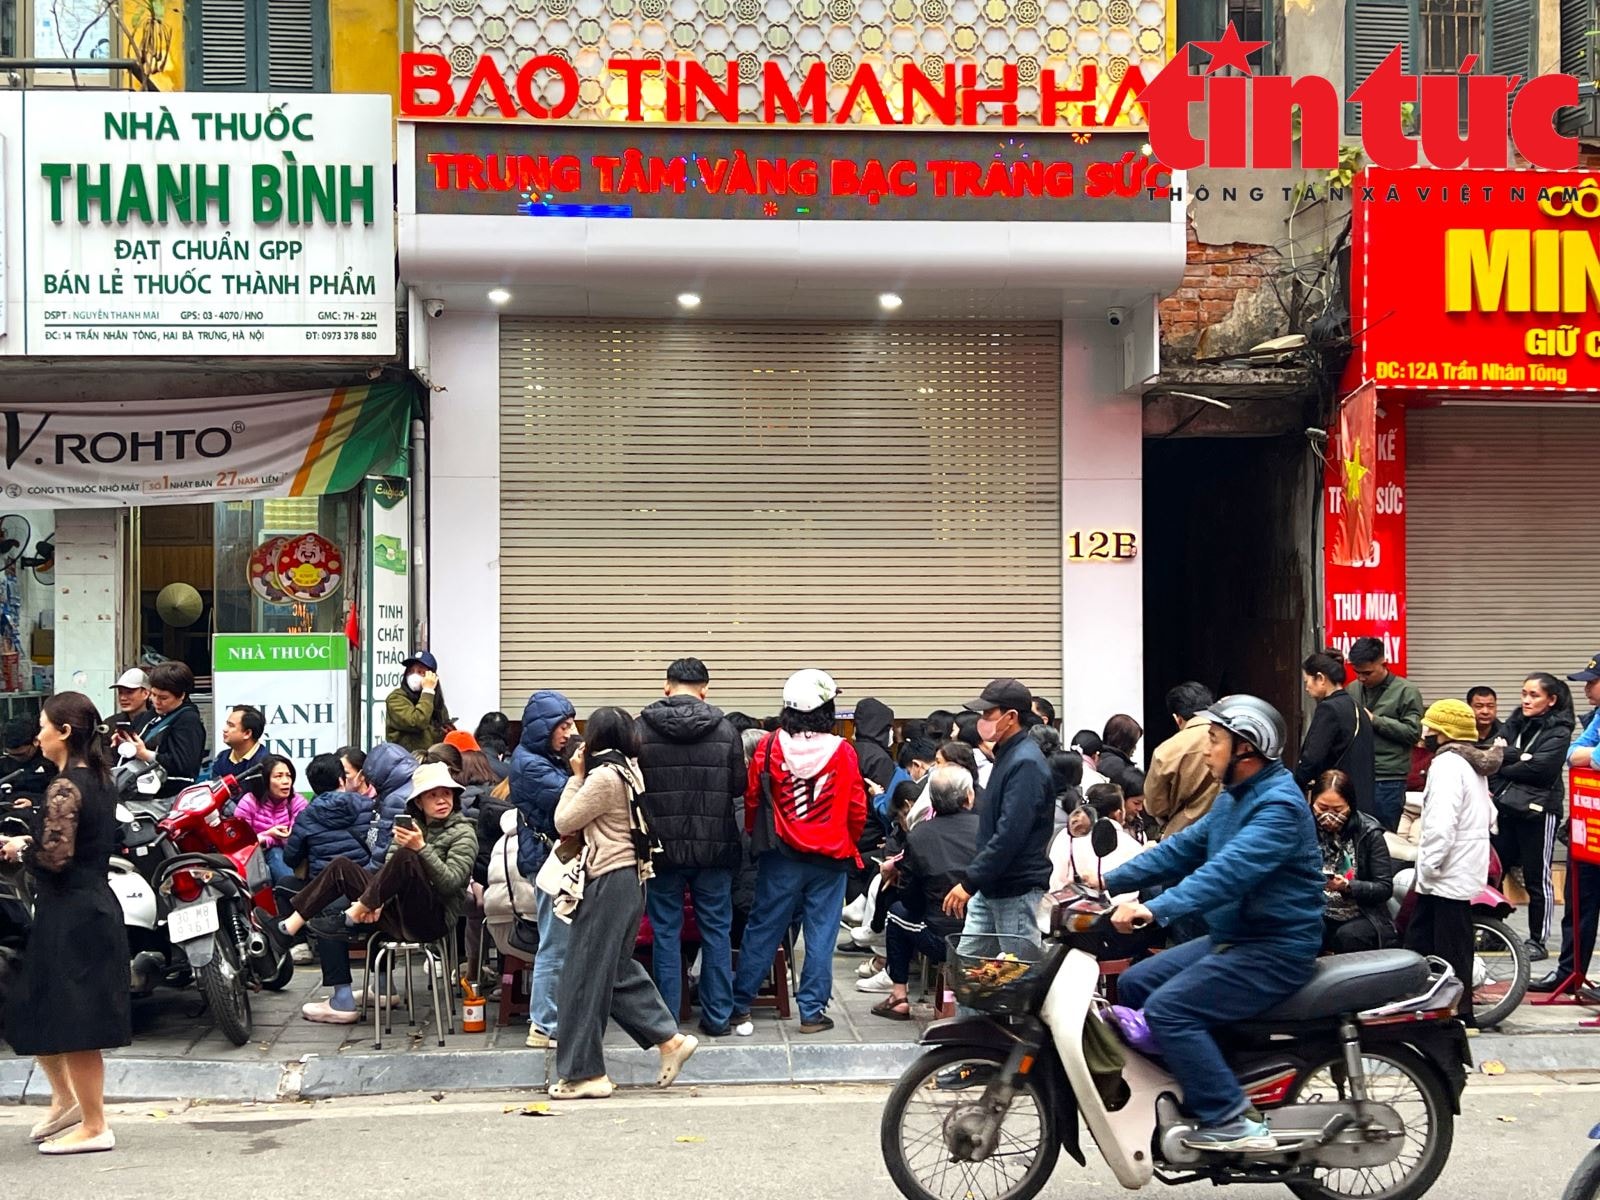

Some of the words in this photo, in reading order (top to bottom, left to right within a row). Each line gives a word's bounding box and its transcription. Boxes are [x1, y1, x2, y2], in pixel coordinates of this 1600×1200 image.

[104, 106, 179, 141] NHÀ
[192, 102, 314, 142] THUỐC
[41, 163, 230, 224] THANH
[252, 151, 375, 225] BÌNH
[427, 152, 582, 191] TRUNG
[591, 147, 687, 195] TÂM
[696, 149, 818, 196] VÀNG
[831, 159, 918, 206] BẠC
[1084, 151, 1173, 199] SỨC
[114, 239, 161, 264] ĐẠT
[172, 231, 249, 261] CHUẨN
[259, 240, 303, 261] GPP
[44, 270, 90, 295] BÁN
[99, 268, 124, 295] LẺ
[134, 268, 212, 295] THUỐC
[222, 270, 300, 295] THÀNH
[309, 267, 376, 296] PHẨM
[110, 311, 141, 320] THANH
[143, 311, 160, 320] MAI
[317, 311, 341, 321] GMC:
[45, 331, 62, 340] ĐC:
[163, 331, 178, 340] HAI
[181, 329, 194, 341] BÀ
[232, 329, 246, 341] HÀ
[305, 331, 320, 341] ĐT:
[321, 331, 342, 341] 0973
[343, 331, 359, 341] 378
[361, 331, 377, 341] 880
[1525, 325, 1580, 357] GIỮ
[1376, 361, 1406, 380] ĐC:
[1408, 362, 1438, 380] 12A
[1482, 365, 1525, 381] Nhân
[1529, 364, 1567, 384] Tông
[1377, 428, 1399, 461] KẾ
[216, 471, 238, 486] 27
[1376, 481, 1404, 515] SỨC
[1068, 531, 1138, 559] 12B
[378, 604, 404, 619] TINH
[1333, 593, 1362, 621] THU
[1365, 593, 1399, 621] MUA
[377, 624, 405, 642] CHẤT
[228, 644, 266, 660] NHÀ
[225, 703, 335, 725] ANH
[263, 733, 318, 759] ÌNH
